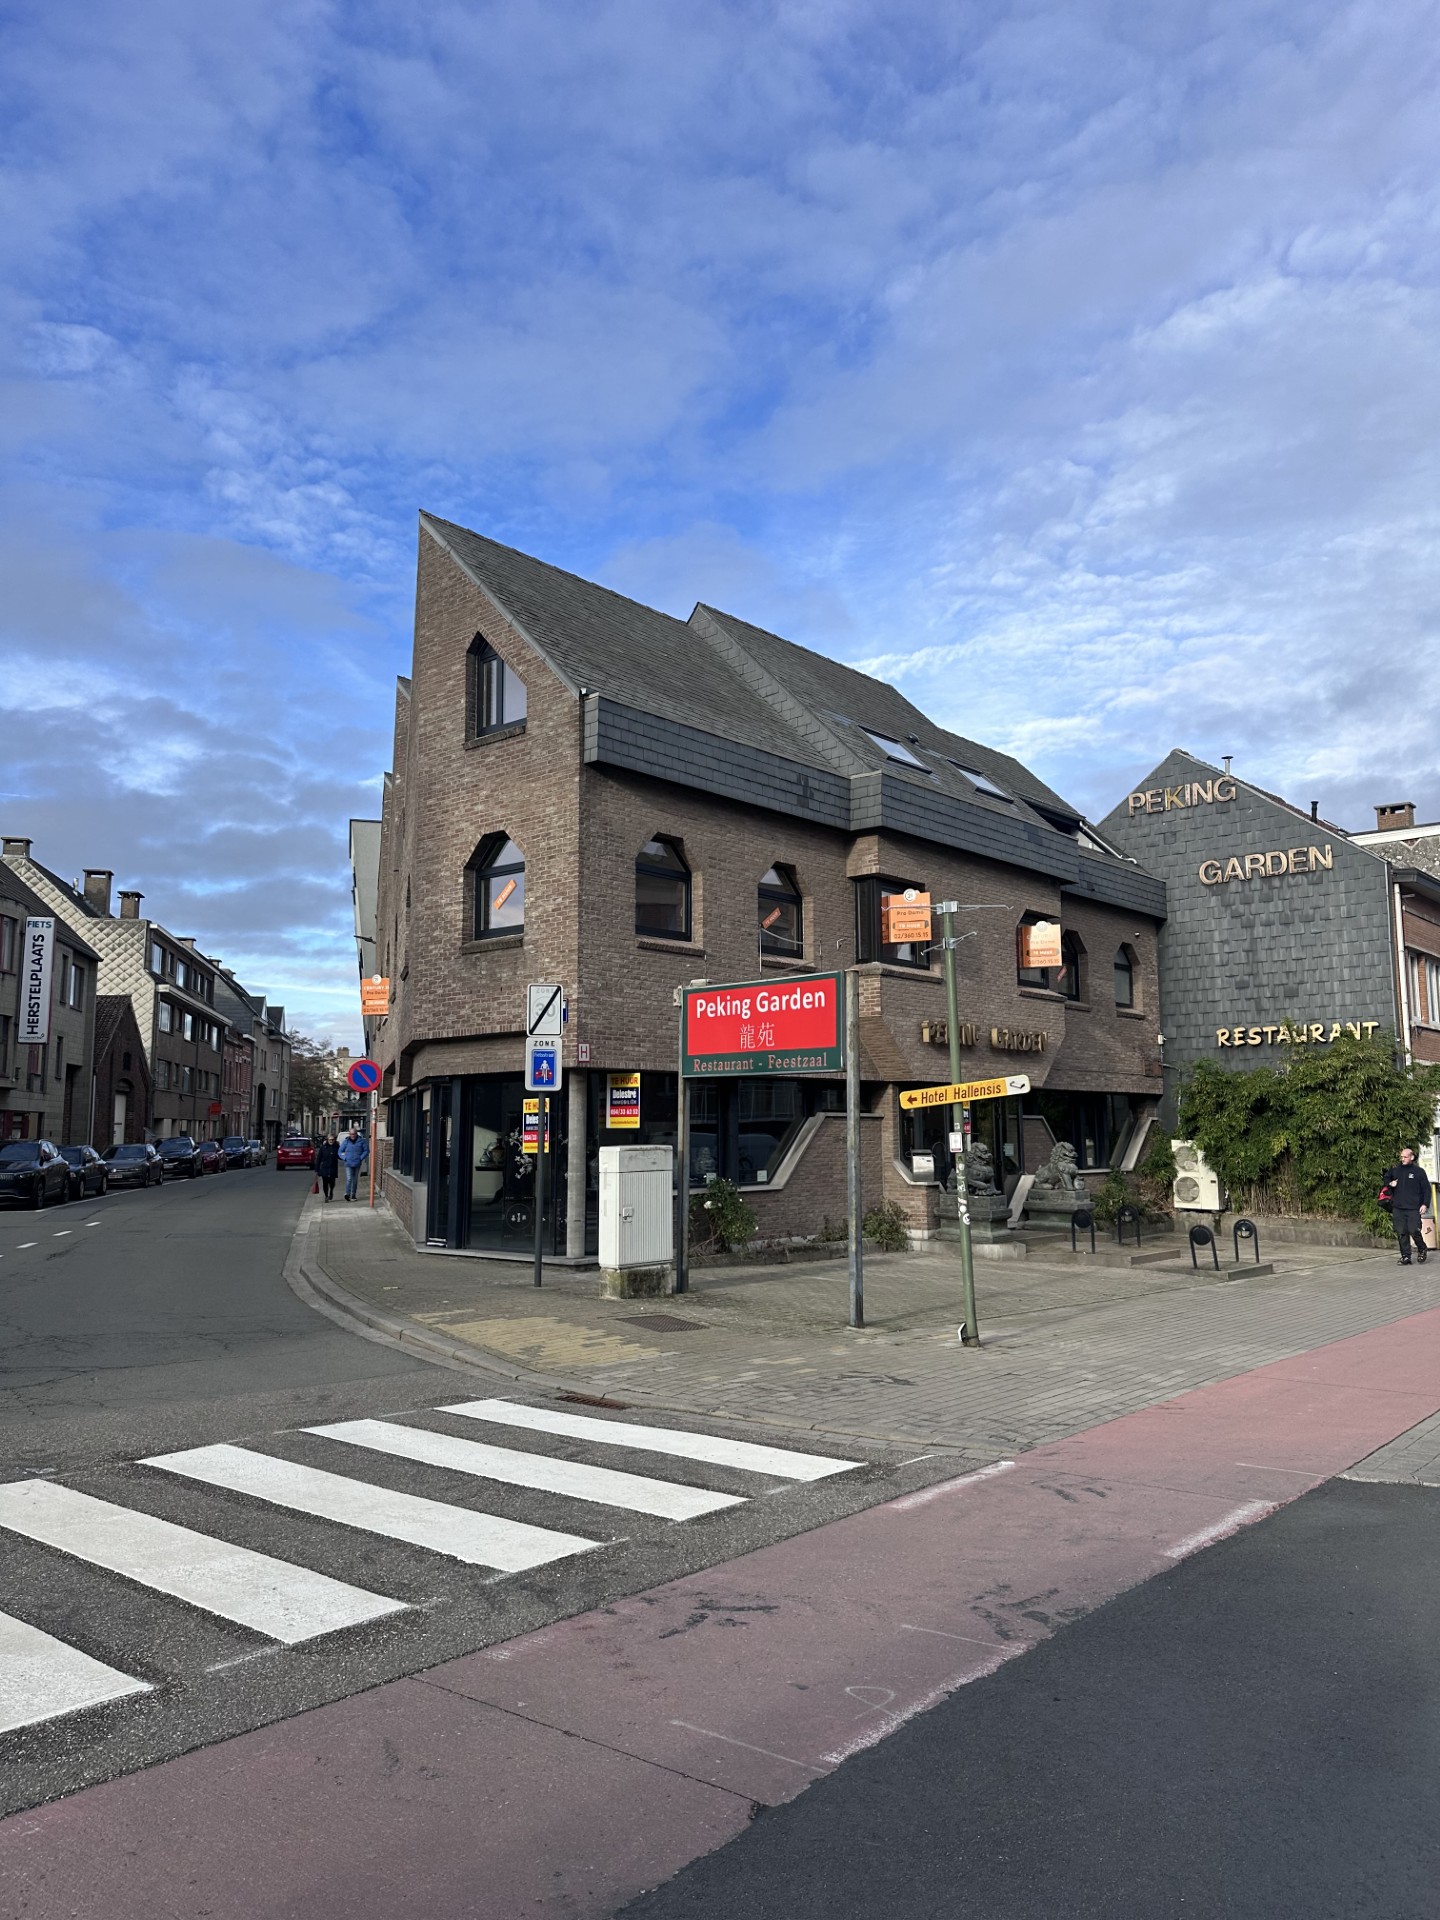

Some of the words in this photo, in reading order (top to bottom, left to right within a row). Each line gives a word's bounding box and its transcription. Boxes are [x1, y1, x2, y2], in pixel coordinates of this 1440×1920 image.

[1128, 776, 1237, 817] PEKING
[1198, 844, 1334, 886] GARDEN
[27, 920, 52, 929] FIETS
[26, 933, 45, 1035] HERSTELPLAATS
[535, 1002, 556, 1018] 30
[696, 994, 751, 1020] Peking
[756, 987, 826, 1013] Garden
[739, 1021, 775, 1050] 龍苑
[991, 1027, 1049, 1052] GARDEN
[1216, 1021, 1380, 1047] RESTAURANT
[580, 1046, 588, 1059] H
[693, 1058, 755, 1072] Restaurant
[768, 1052, 827, 1069] Feestzaal
[611, 1077, 620, 1086] TE
[620, 1076, 639, 1085] HUUR
[612, 1088, 637, 1099] Delestré
[921, 1089, 948, 1105] Hotel
[953, 1084, 1002, 1100] Hallensis
[524, 1102, 532, 1111] TE
